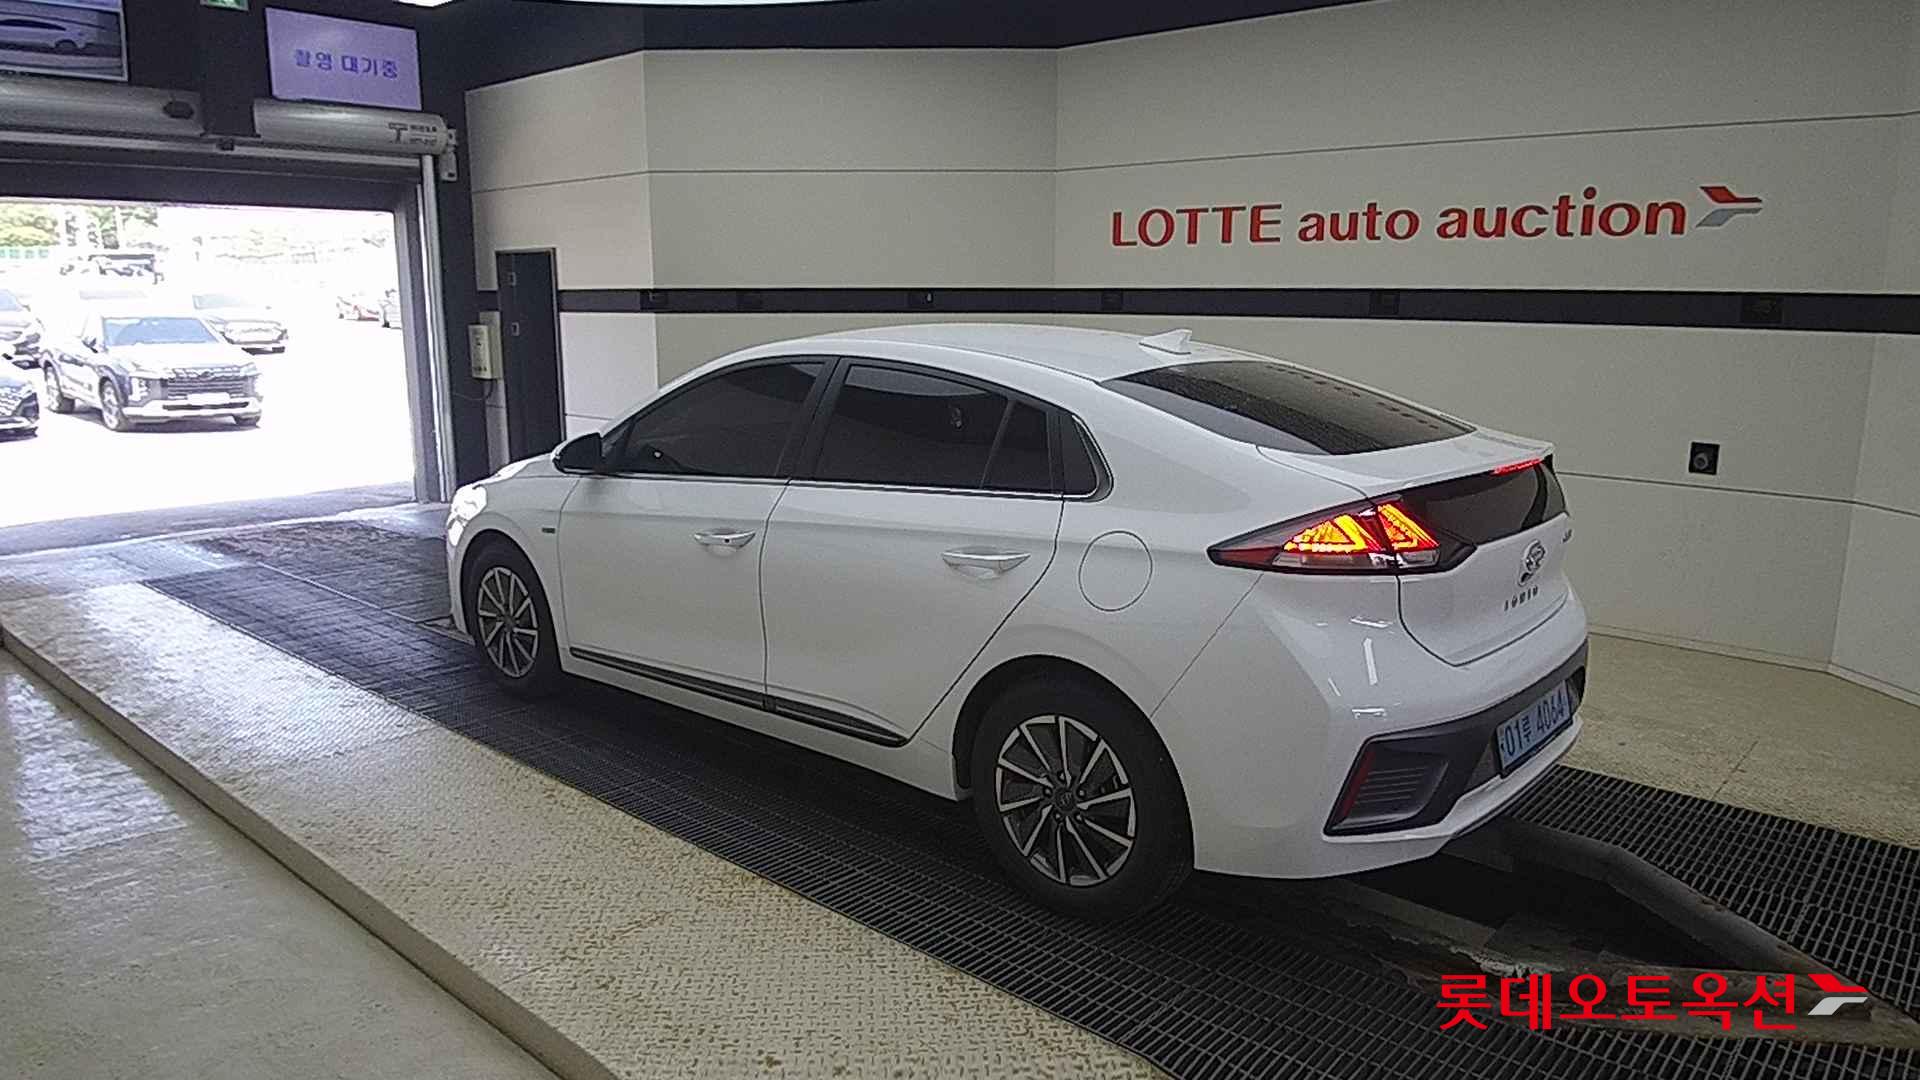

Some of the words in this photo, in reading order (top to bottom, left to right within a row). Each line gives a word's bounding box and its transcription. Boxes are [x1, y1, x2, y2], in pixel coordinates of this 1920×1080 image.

[341, 55, 398, 79] 대기중
[1113, 203, 1282, 247] LOTTE
[1299, 203, 1420, 241] auto
[1437, 186, 1686, 239] auction
